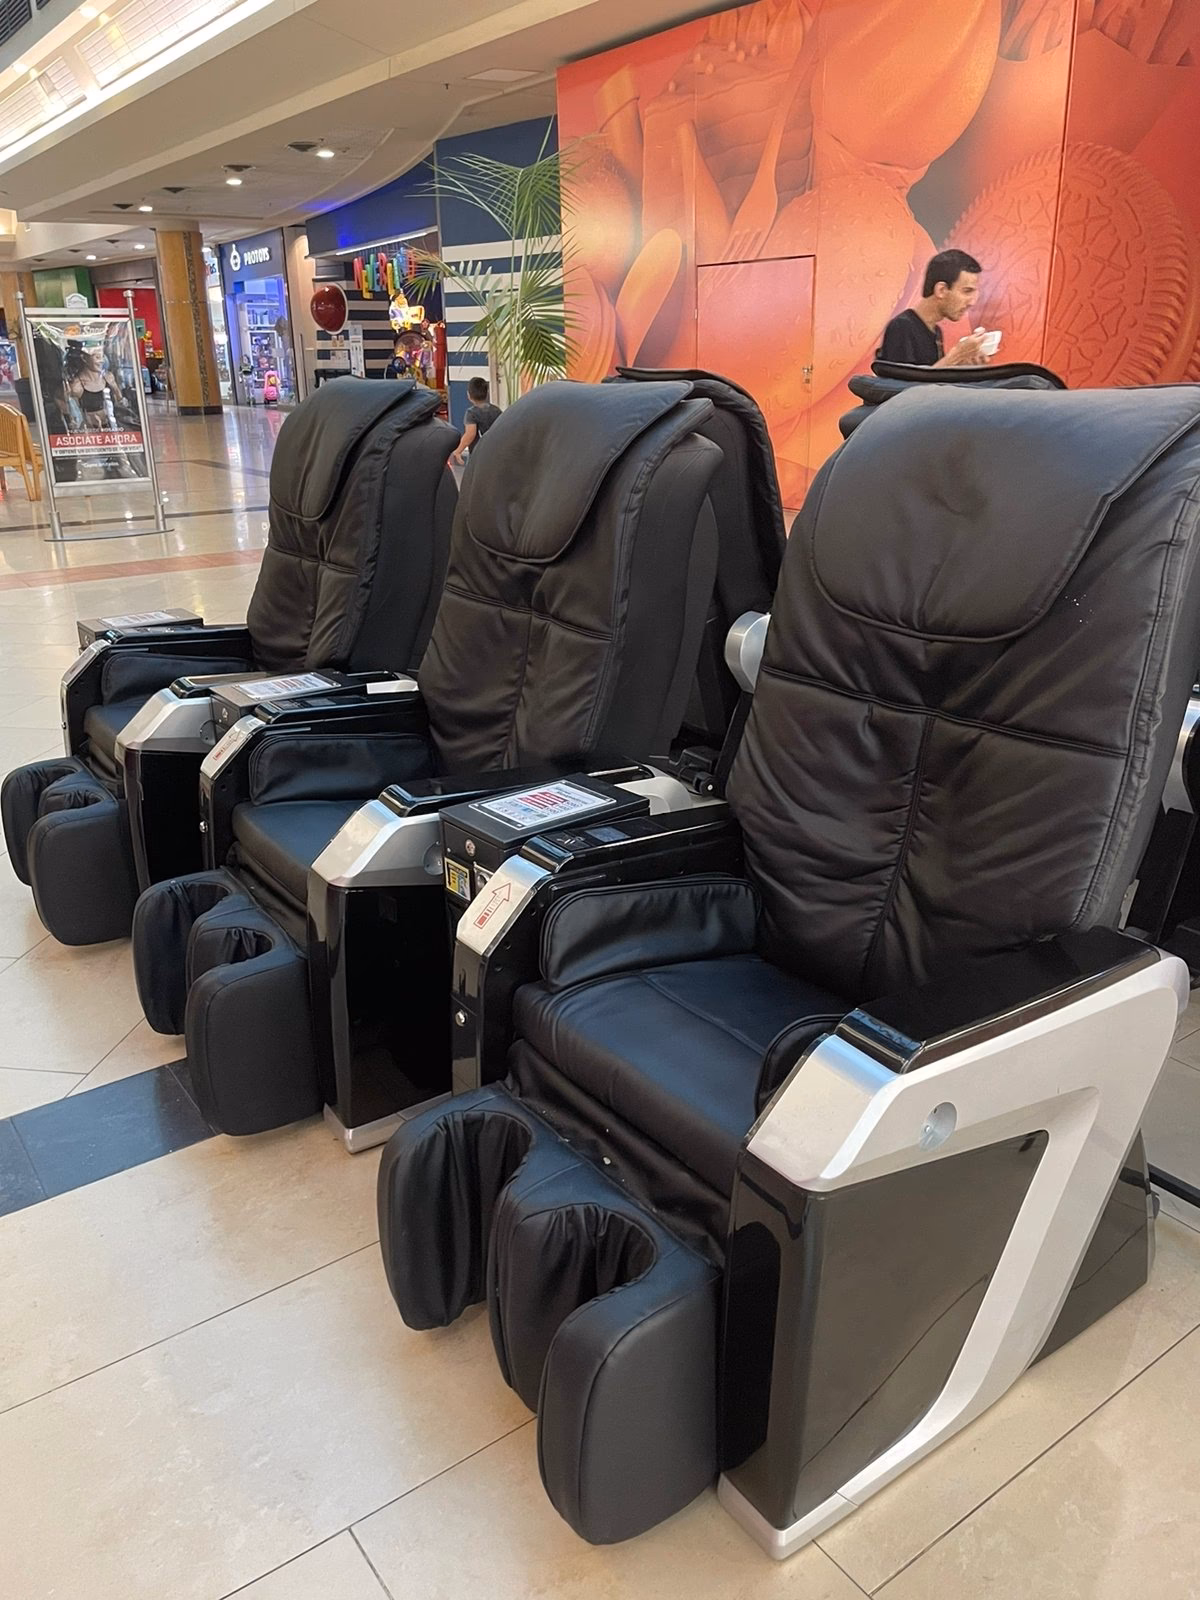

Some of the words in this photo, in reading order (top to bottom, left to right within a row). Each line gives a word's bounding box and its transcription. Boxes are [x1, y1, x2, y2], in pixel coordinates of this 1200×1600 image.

[244, 247, 270, 266] PROTOYS
[56, 435, 102, 446] ASOCIATE
[104, 434, 137, 443] AHORA
